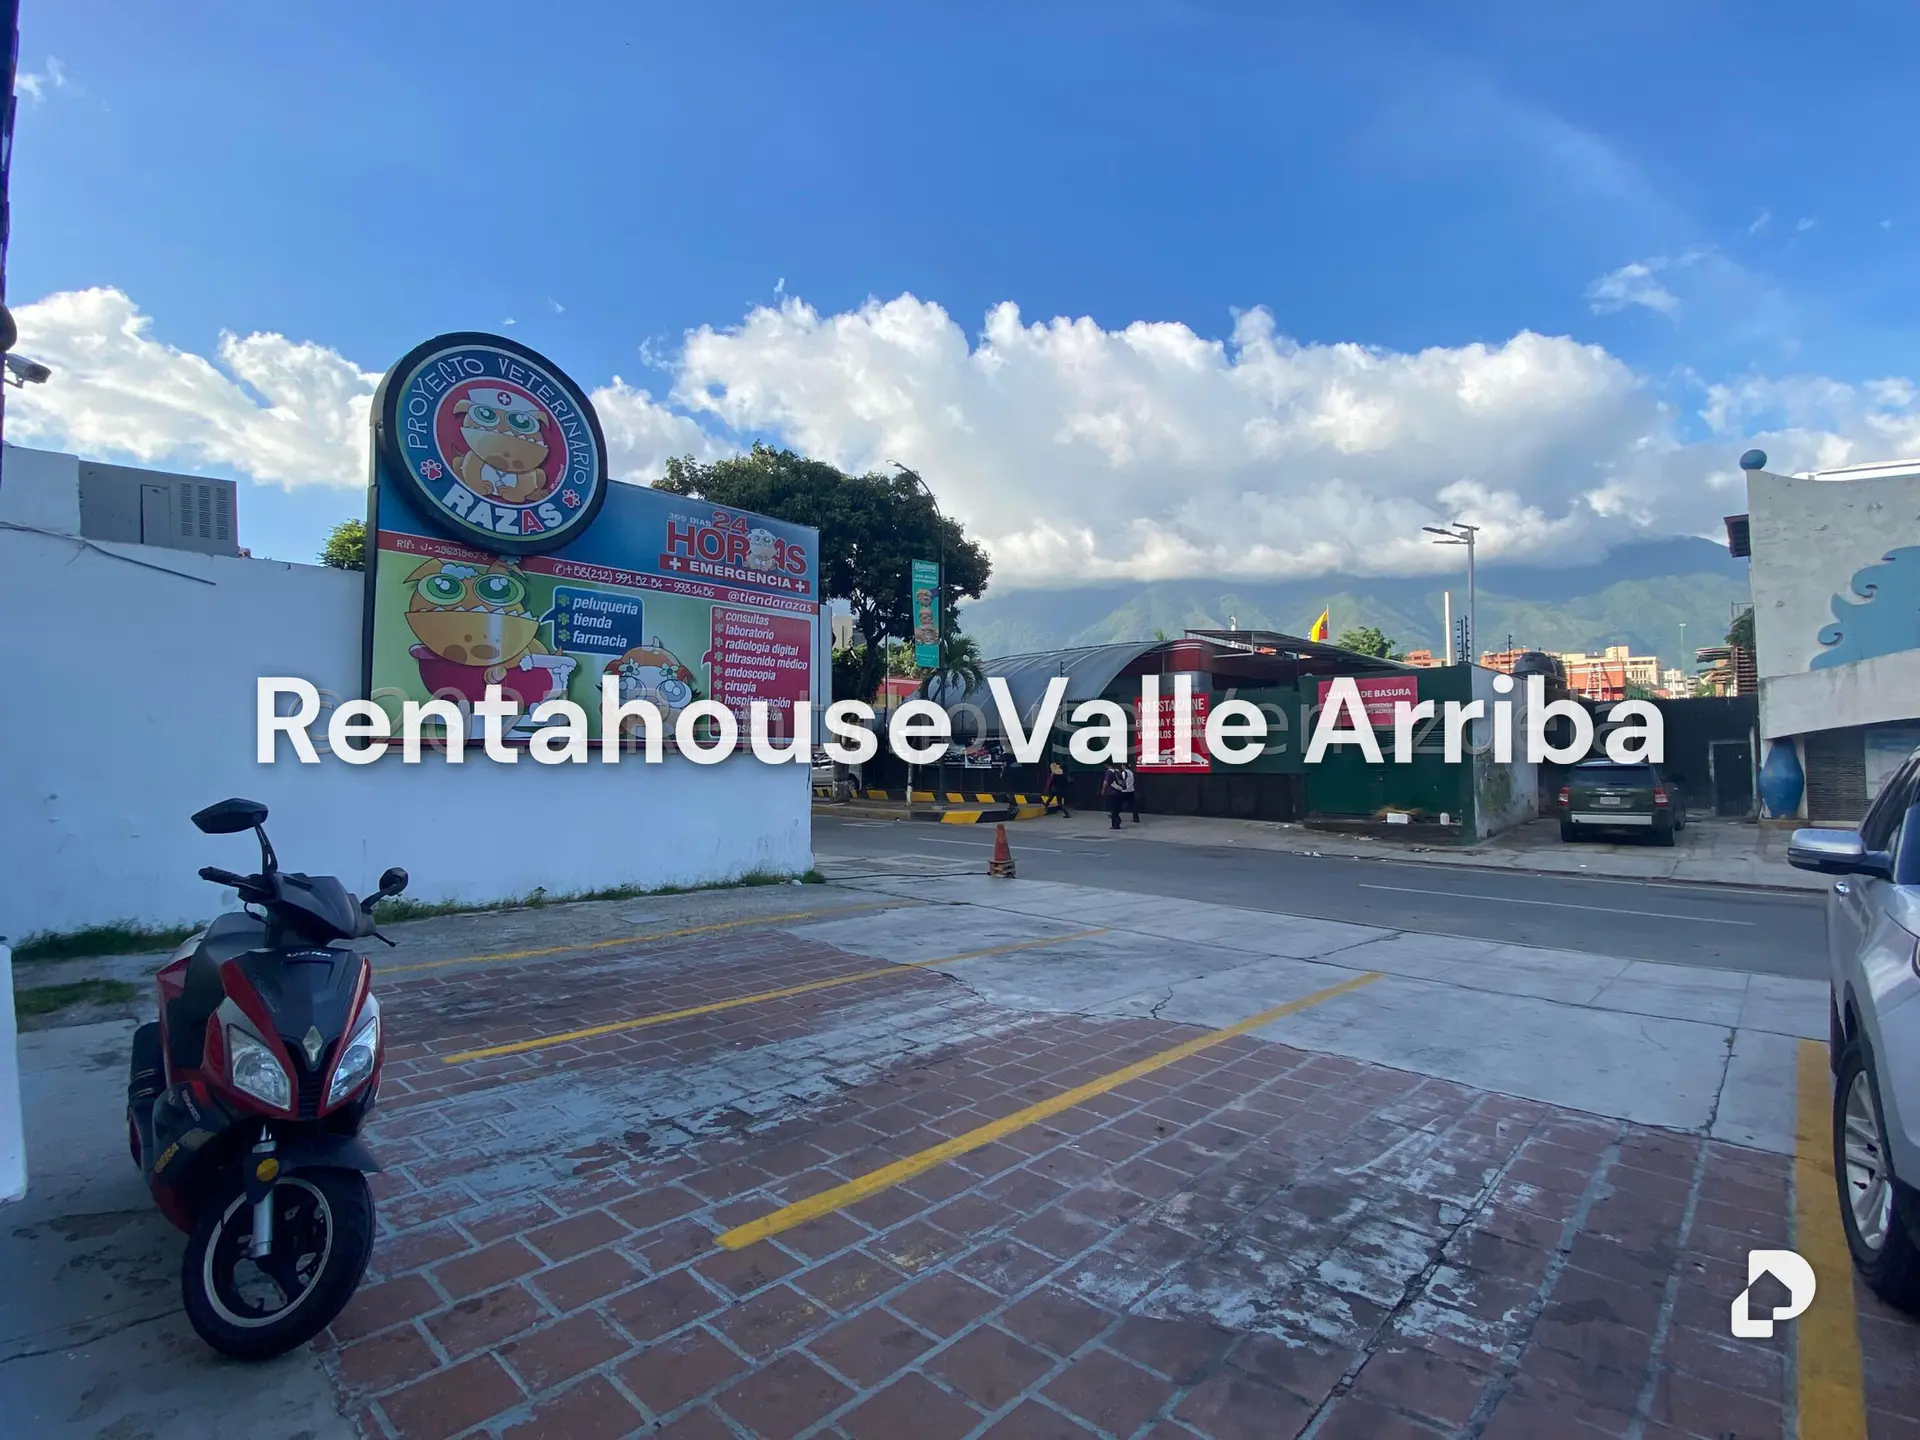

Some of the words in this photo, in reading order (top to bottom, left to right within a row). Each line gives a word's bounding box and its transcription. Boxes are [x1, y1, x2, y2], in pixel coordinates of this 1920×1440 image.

[408, 356, 485, 450] PROYECTO
[498, 358, 590, 485] VETERINARIO
[441, 483, 563, 535] RAZAS
[712, 511, 749, 534] 24
[667, 520, 807, 576] HORAS
[689, 560, 792, 589] EMERGENCIA
[727, 589, 812, 613] @tiendarazas
[573, 613, 613, 629] tienda
[725, 612, 770, 626] consultas
[572, 630, 628, 648] farmacia
[725, 624, 775, 640] laboratorio
[725, 639, 770, 654] radiología
[772, 643, 799, 657] digital
[725, 652, 776, 667] ultrasonido
[777, 657, 808, 670] médico
[724, 680, 757, 694] cirugía
[1361, 690, 1373, 698] DE
[1374, 688, 1411, 698] BASURA
[1166, 718, 1170, 726] Y
